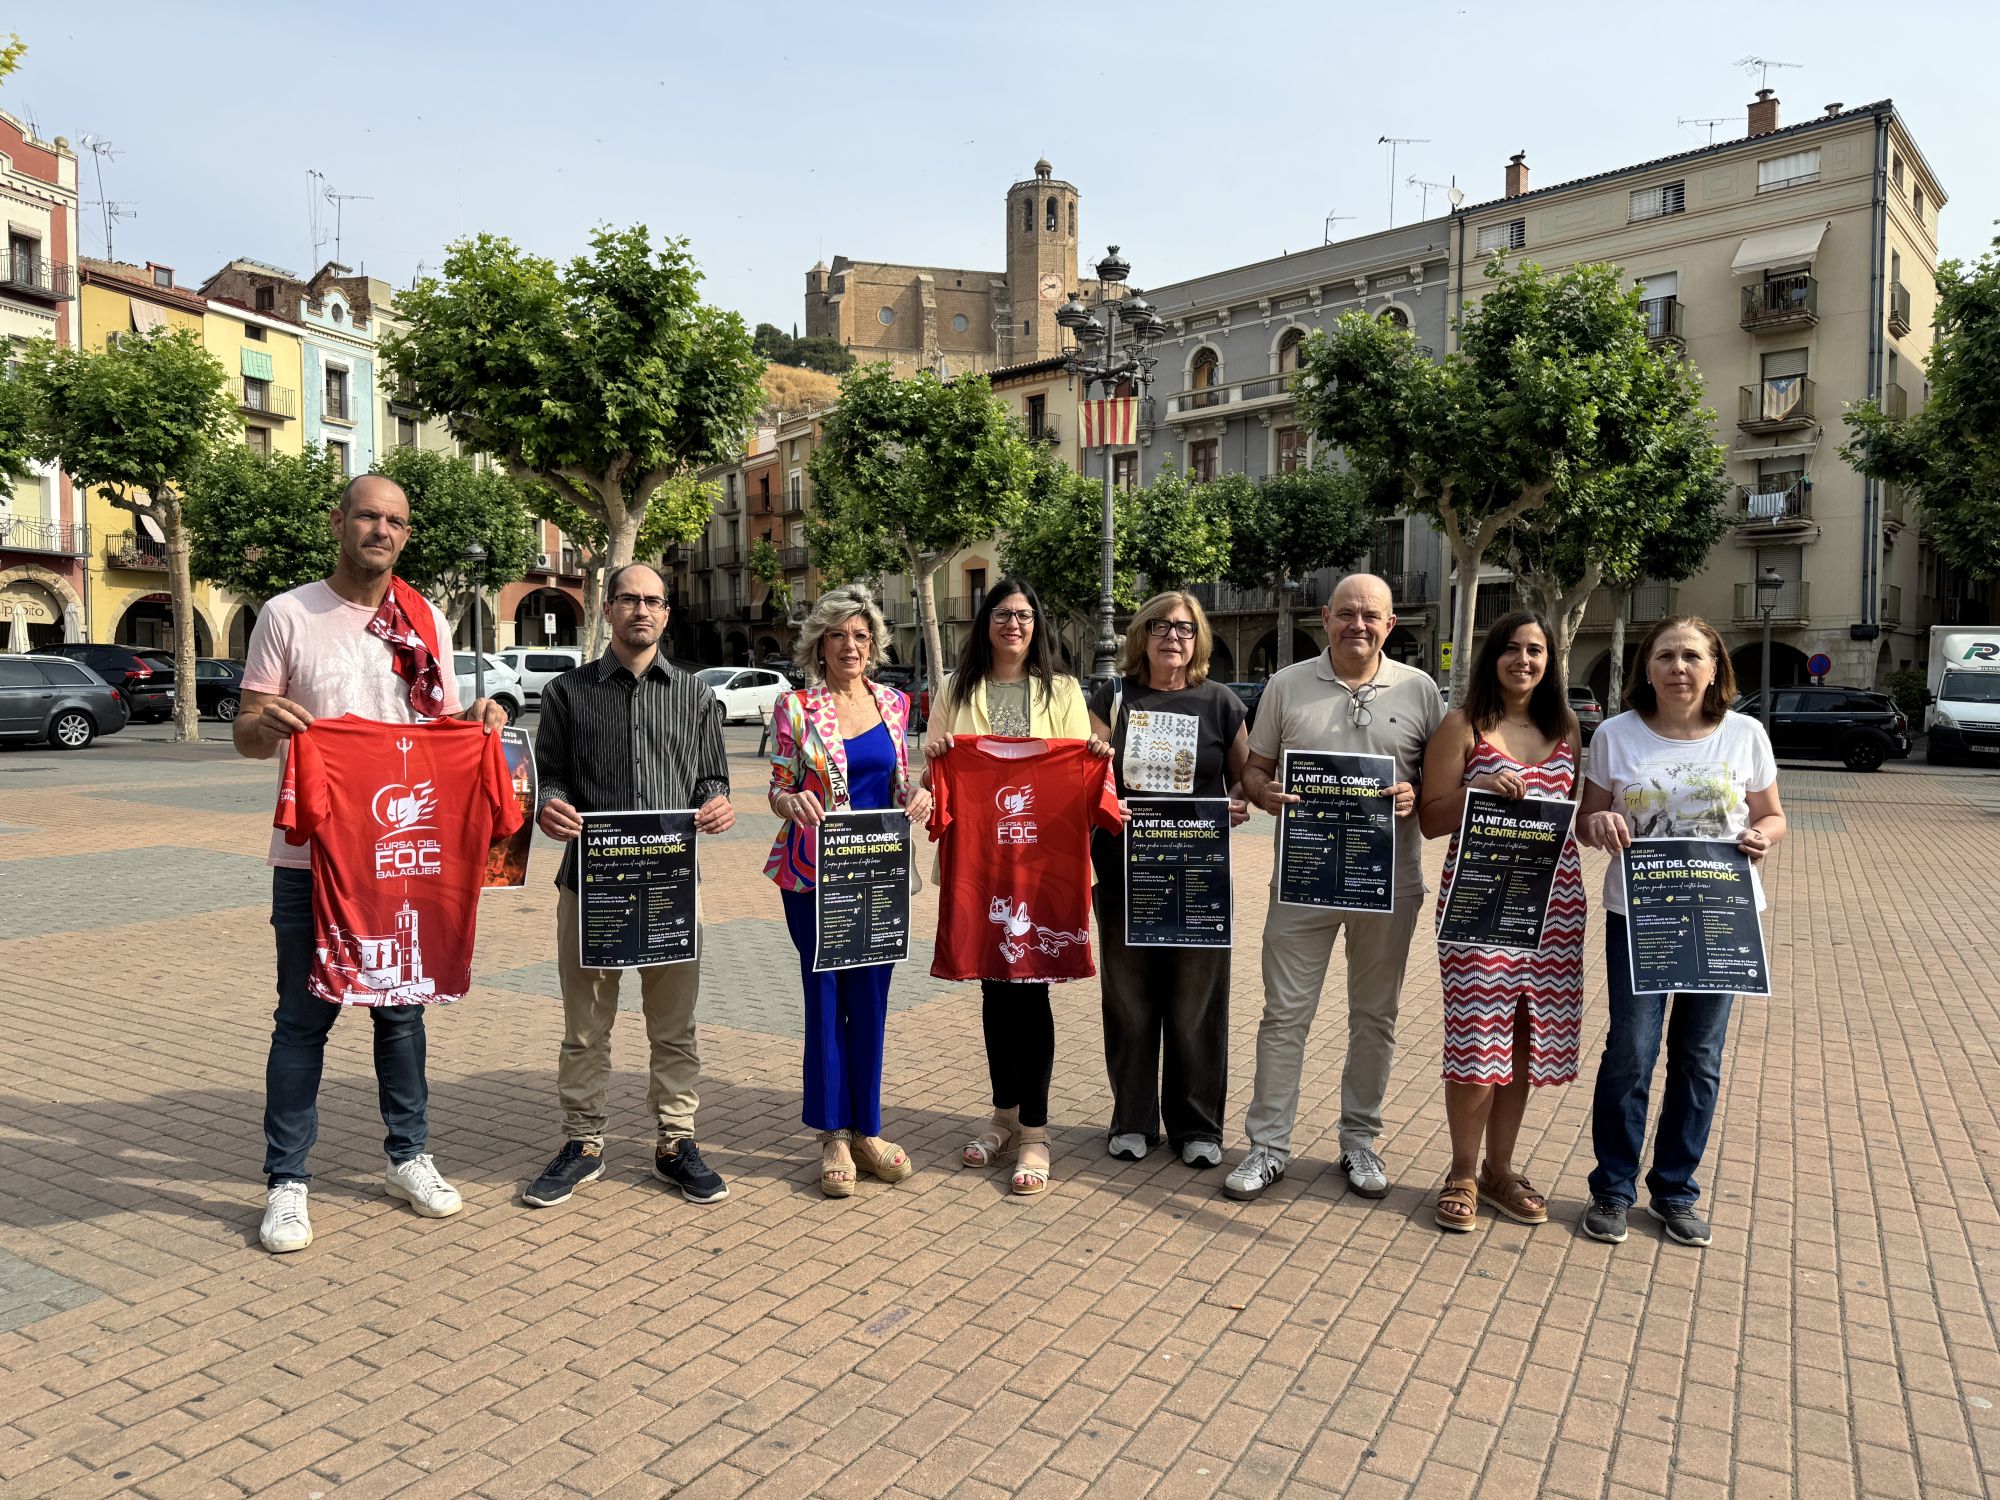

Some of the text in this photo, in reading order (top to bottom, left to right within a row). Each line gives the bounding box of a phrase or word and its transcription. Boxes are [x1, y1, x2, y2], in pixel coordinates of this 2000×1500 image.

[1322, 775, 1338, 783] DEL
[1340, 776, 1379, 788] COMERÇ
[1177, 820, 1214, 830] COMERÇ
[1472, 813, 1555, 832] LA NIT DEL COMERÇ
[603, 836, 618, 844] NIT
[620, 836, 637, 844] DEL
[640, 833, 681, 844] COMERÇ
[824, 832, 898, 844] LA NIT DEL COMERÇ
[998, 826, 1037, 839] FOC
[1485, 827, 1517, 837] CENTRE
[1518, 831, 1552, 840] HISTÒRIC
[375, 840, 414, 851] CURSA
[602, 847, 639, 855] CENTRE
[642, 843, 684, 854] HISTÒRIC
[837, 845, 866, 854] CENTRE
[867, 842, 901, 852] HISTÒRIC
[375, 848, 441, 871] FOC
[1666, 860, 1685, 870] DEL
[1687, 859, 1732, 872] COMERÇ
[376, 867, 441, 879] BALAGUER
[1692, 871, 1735, 880] HISTÒRIC
